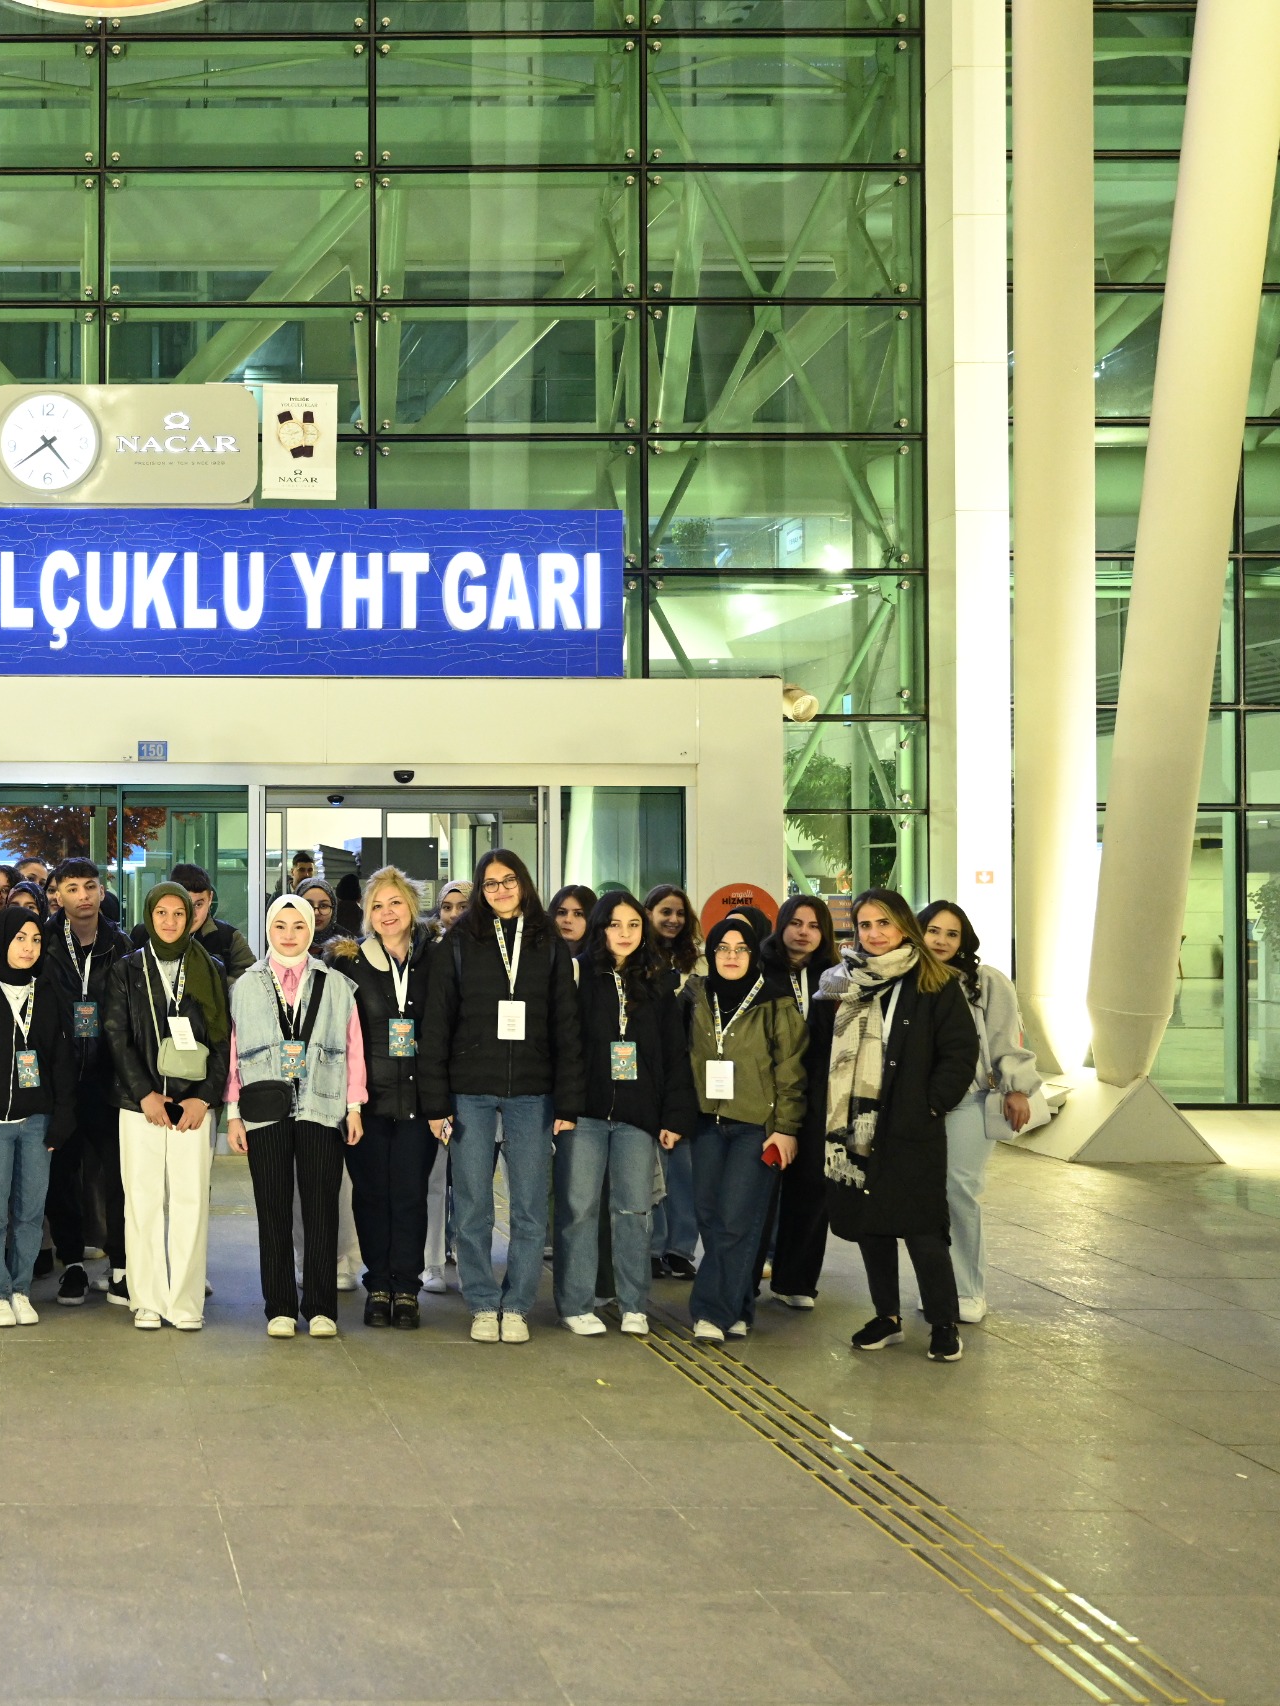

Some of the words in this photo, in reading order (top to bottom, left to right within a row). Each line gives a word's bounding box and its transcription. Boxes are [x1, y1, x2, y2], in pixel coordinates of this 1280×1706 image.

[42, 403, 55, 416] 12
[116, 435, 240, 453] NACAR
[43, 472, 53, 485] 6
[290, 551, 430, 630] YHT
[442, 551, 601, 631] GARI
[141, 744, 164, 757] 150
[722, 896, 754, 905] HİZMET
